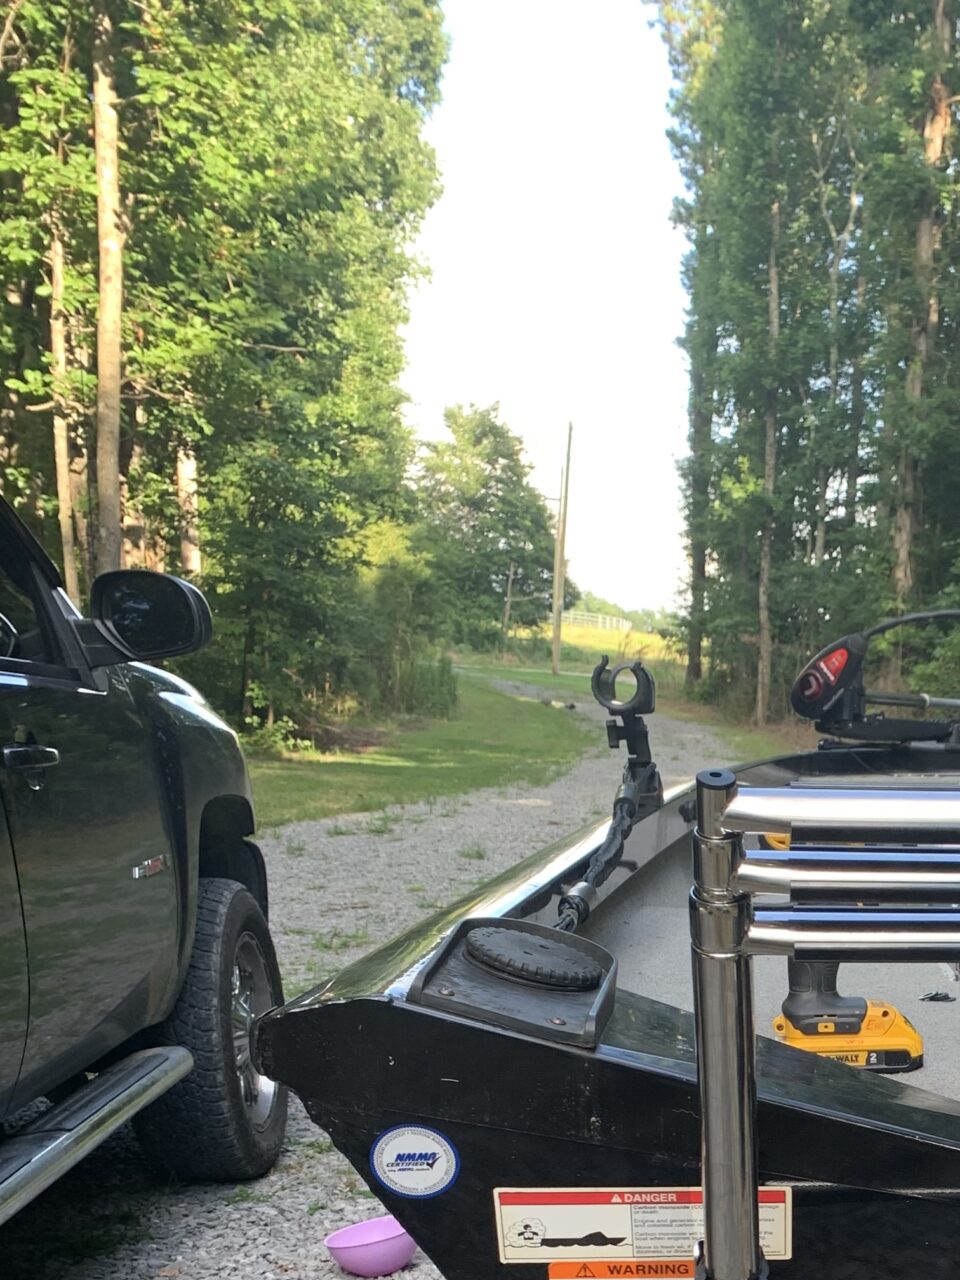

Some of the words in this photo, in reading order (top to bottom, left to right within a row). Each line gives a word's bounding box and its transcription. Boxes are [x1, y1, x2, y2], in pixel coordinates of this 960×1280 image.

[395, 1152, 437, 1162] NMMA
[624, 1193, 677, 1202] DANGER
[607, 1264, 689, 1275] WARNING
